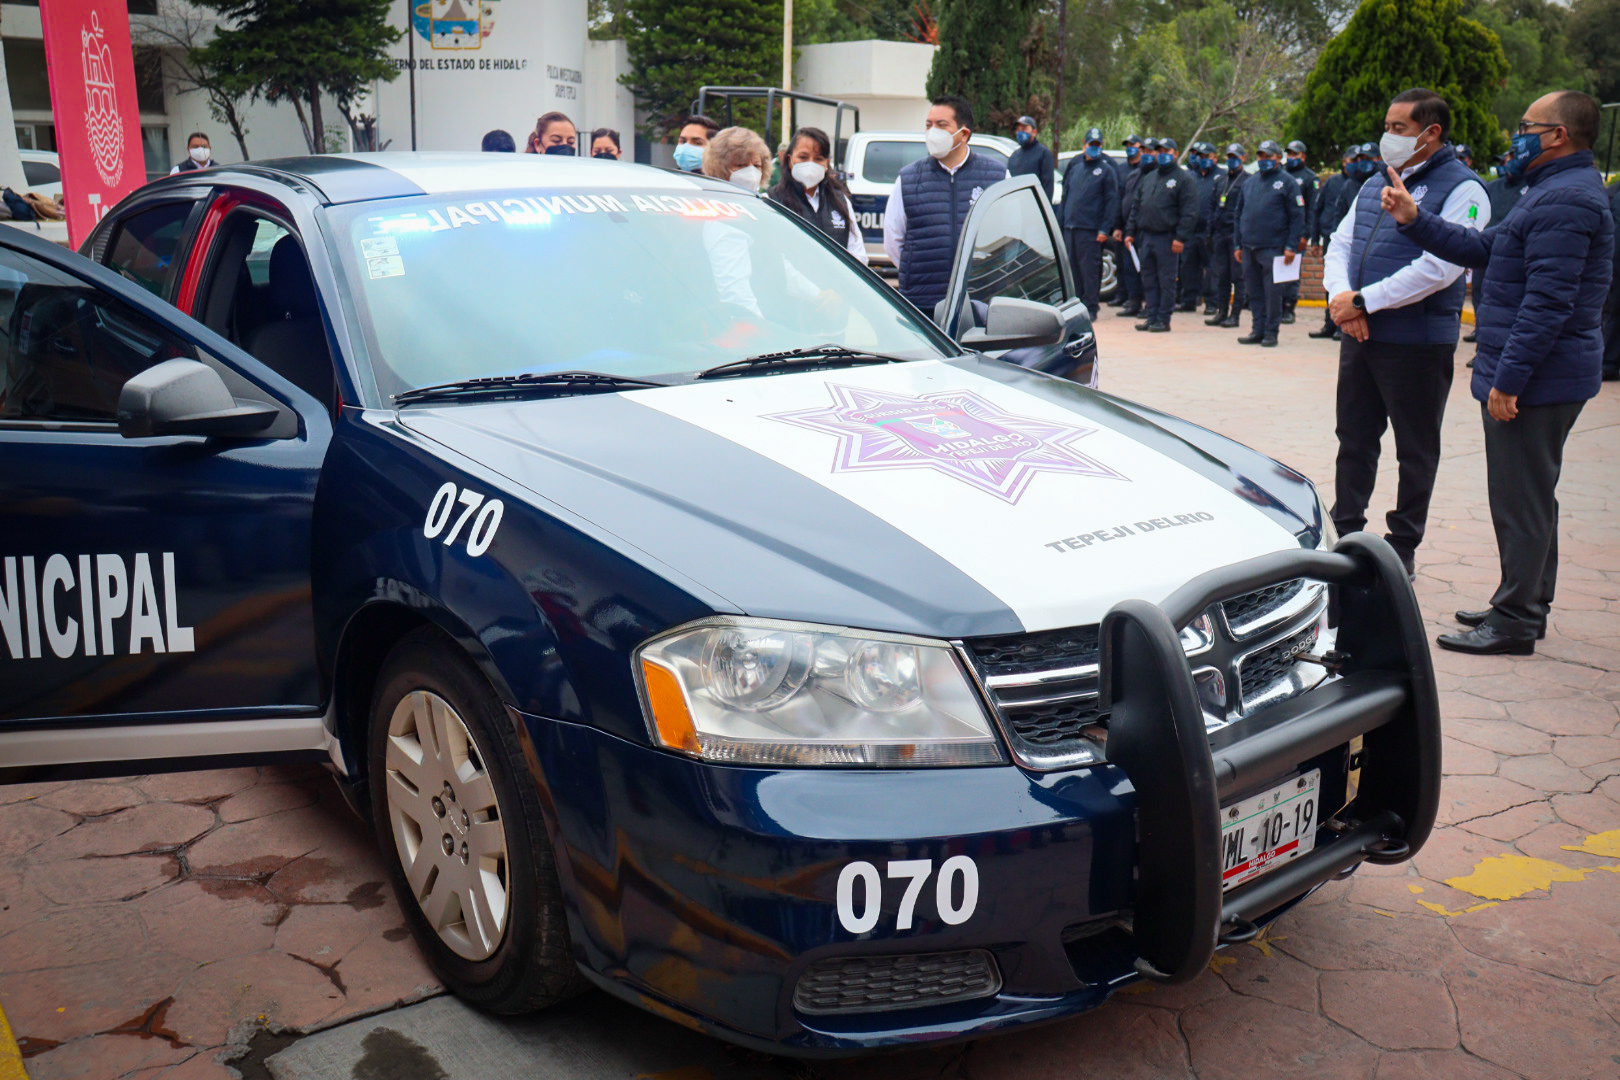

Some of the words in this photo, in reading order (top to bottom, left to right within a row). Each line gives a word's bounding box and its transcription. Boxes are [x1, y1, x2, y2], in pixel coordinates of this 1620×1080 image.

[419, 58, 434, 70] DEL
[437, 58, 475, 70] ESTADO
[479, 58, 492, 70] DE
[855, 212, 884, 229] POLI
[928, 432, 1025, 454] HIDALGO
[423, 481, 505, 558] 070
[1043, 524, 1136, 554] TEPEJI
[1281, 631, 1317, 659] DODGE
[1248, 850, 1277, 869] HIDALGO
[836, 855, 980, 935] 070
